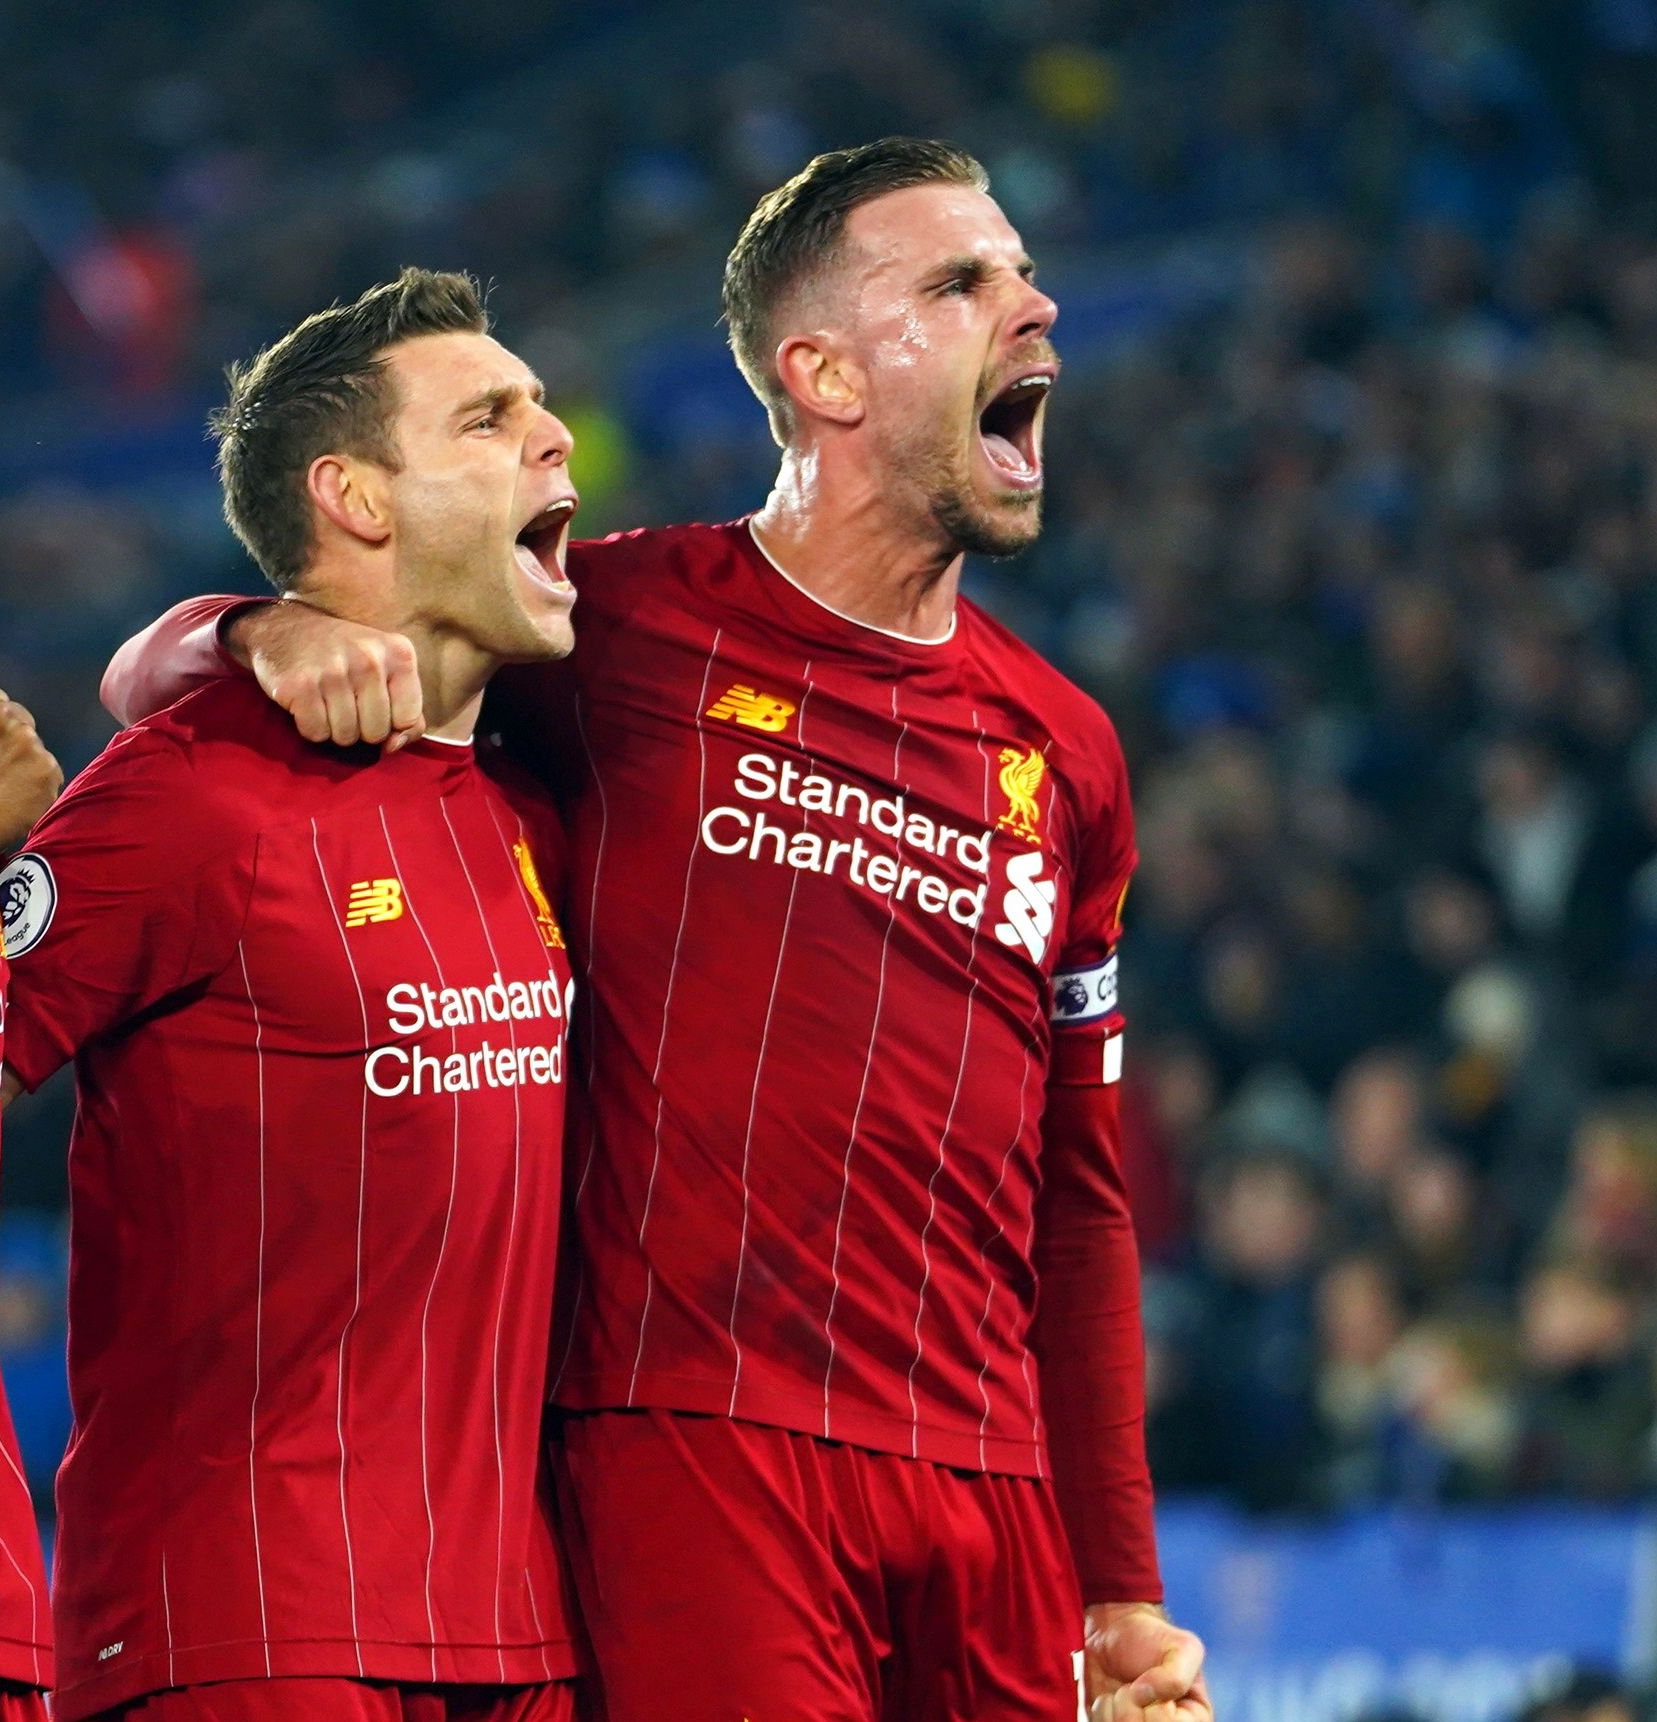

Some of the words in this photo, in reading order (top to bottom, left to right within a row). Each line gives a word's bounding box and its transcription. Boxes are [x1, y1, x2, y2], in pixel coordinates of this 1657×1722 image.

[733, 753, 992, 874] Standard
[701, 806, 987, 929] Chartered
[4, 922, 31, 946] eague
[386, 968, 562, 1035] Standard
[364, 1034, 562, 1097] Chartered
